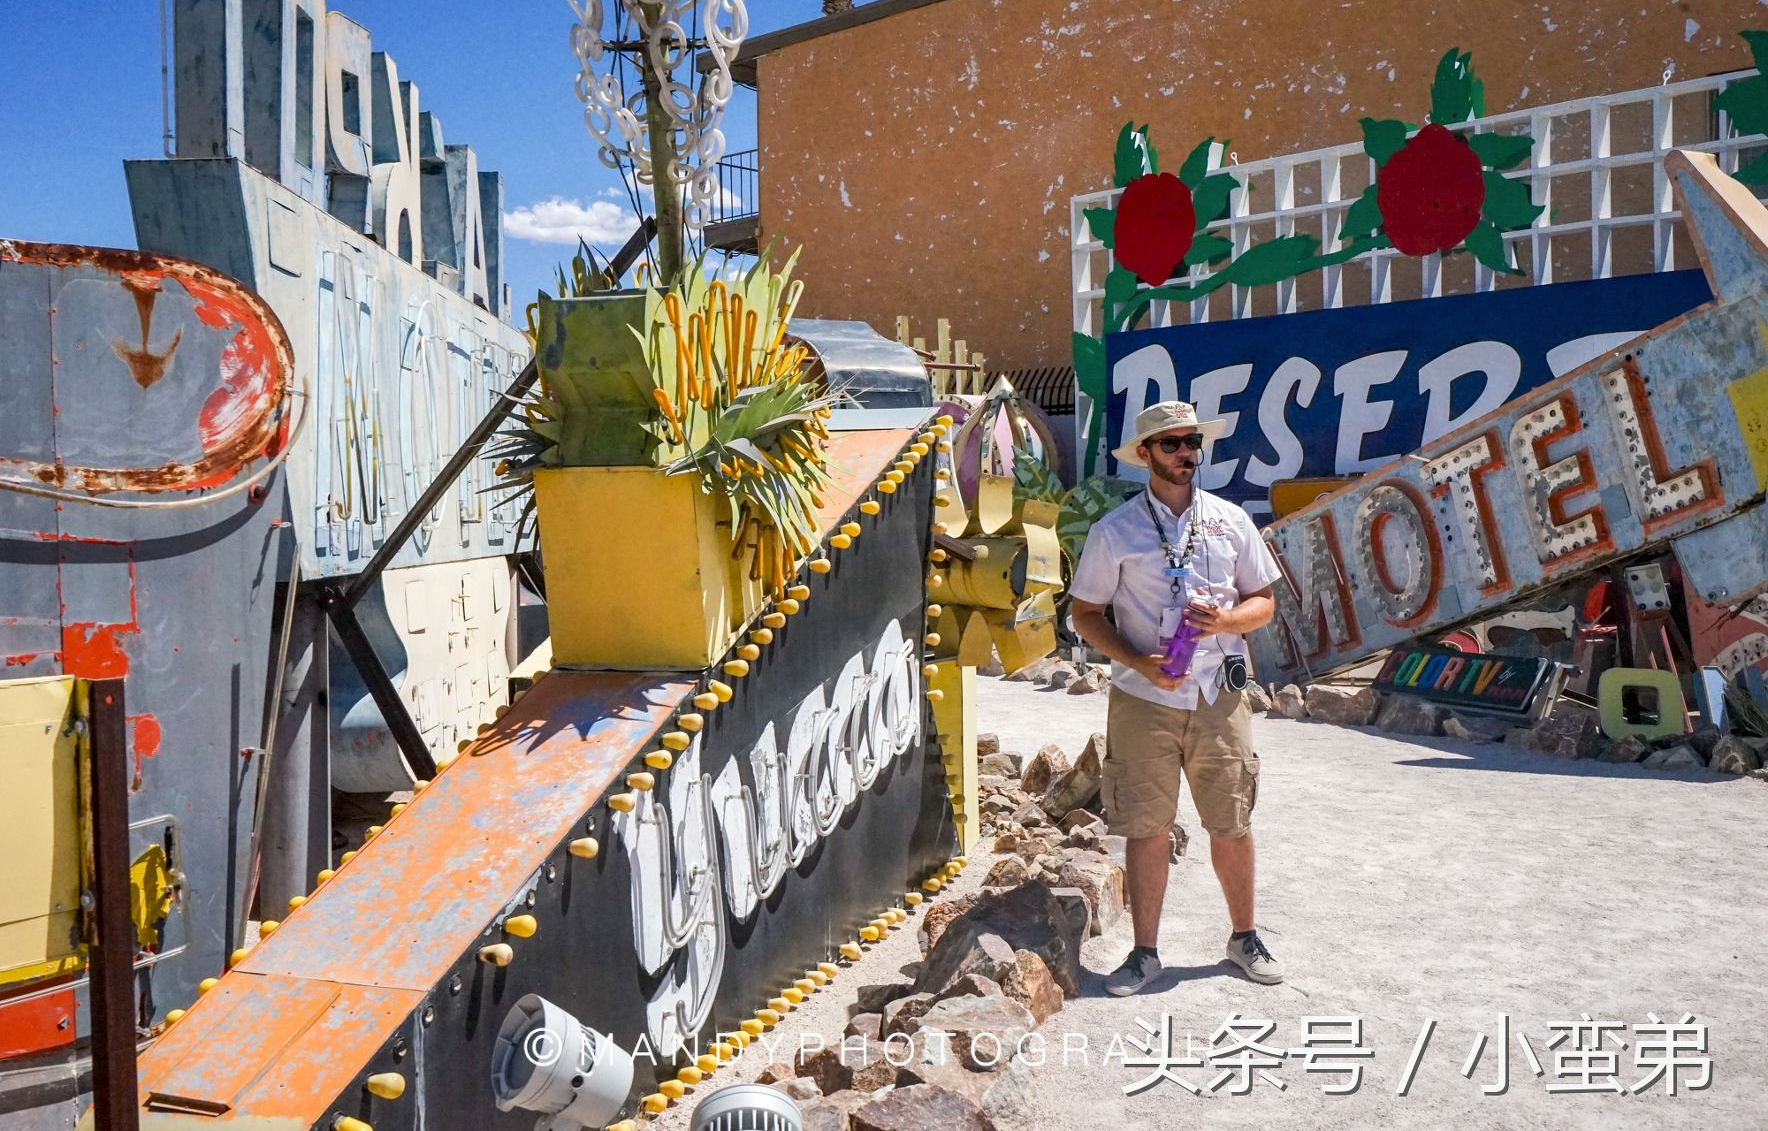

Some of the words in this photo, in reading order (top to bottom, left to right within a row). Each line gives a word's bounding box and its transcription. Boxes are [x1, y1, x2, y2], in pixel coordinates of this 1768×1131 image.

[1261, 363, 1726, 672] MOTEL
[1379, 651, 1465, 691] COLOR
[1457, 659, 1504, 696] TV
